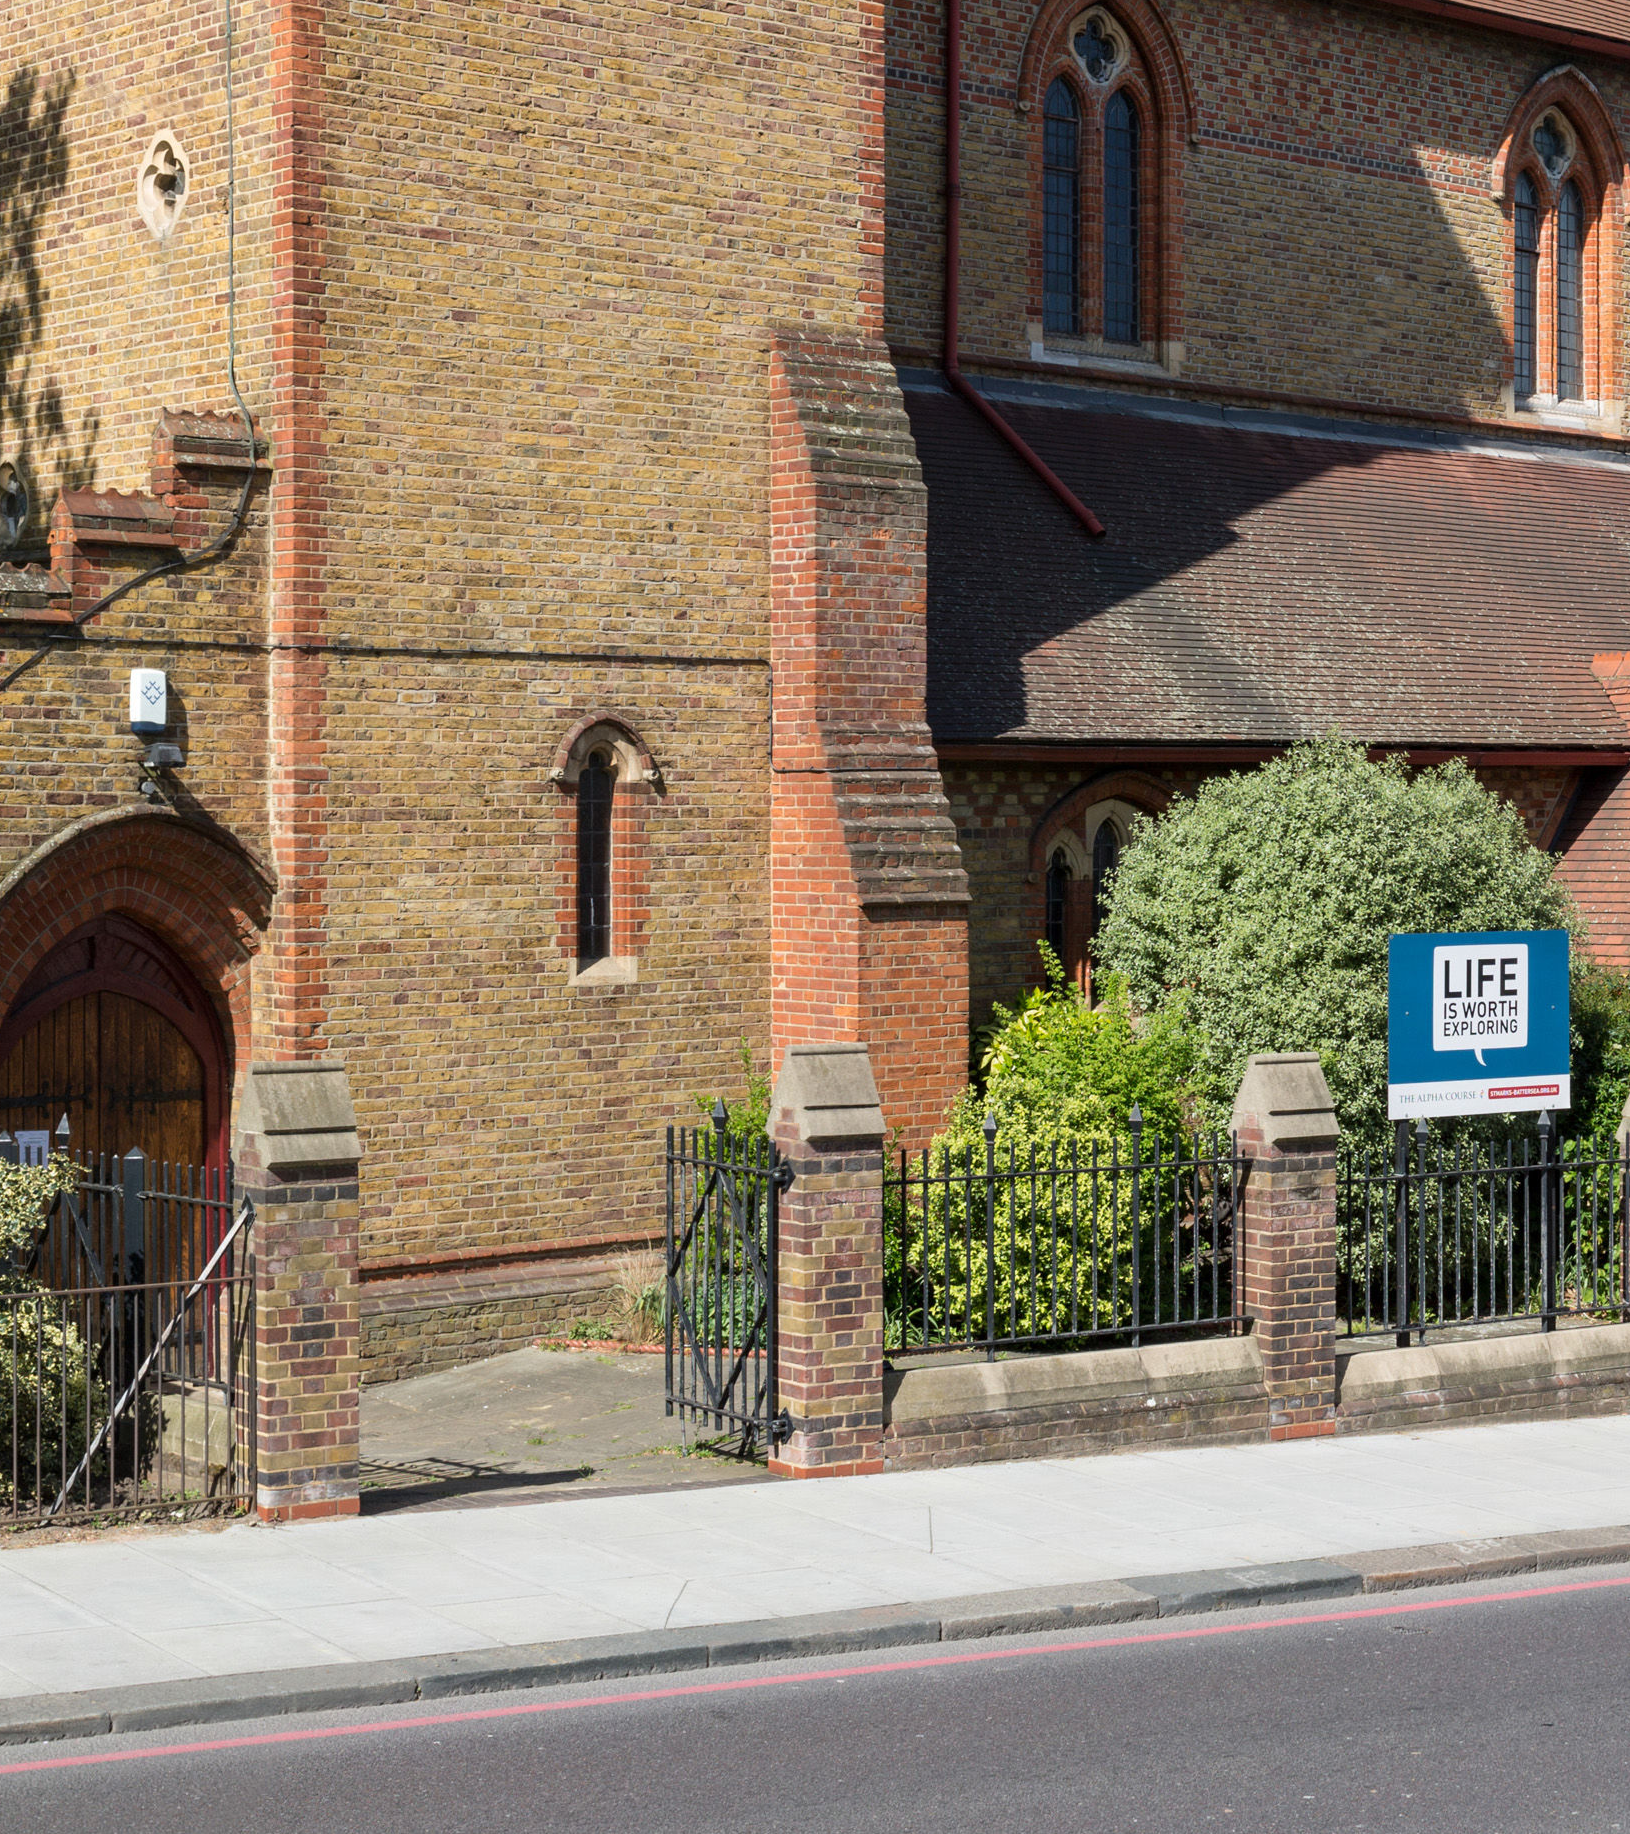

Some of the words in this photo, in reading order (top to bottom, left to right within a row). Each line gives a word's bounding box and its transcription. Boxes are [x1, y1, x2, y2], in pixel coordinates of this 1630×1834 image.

[1444, 958, 1518, 998] LIFE
[1444, 1003, 1457, 1019] IS
[1462, 1000, 1518, 1018] WORTH
[1444, 1019, 1518, 1037] EXPLORING
[1400, 1094, 1415, 1103] THE
[1417, 1093, 1444, 1102] ALPHA
[1445, 1091, 1476, 1101] COURSE
[1490, 1087, 1558, 1097] STMARKS-BATTERSEA.ORG.UK
